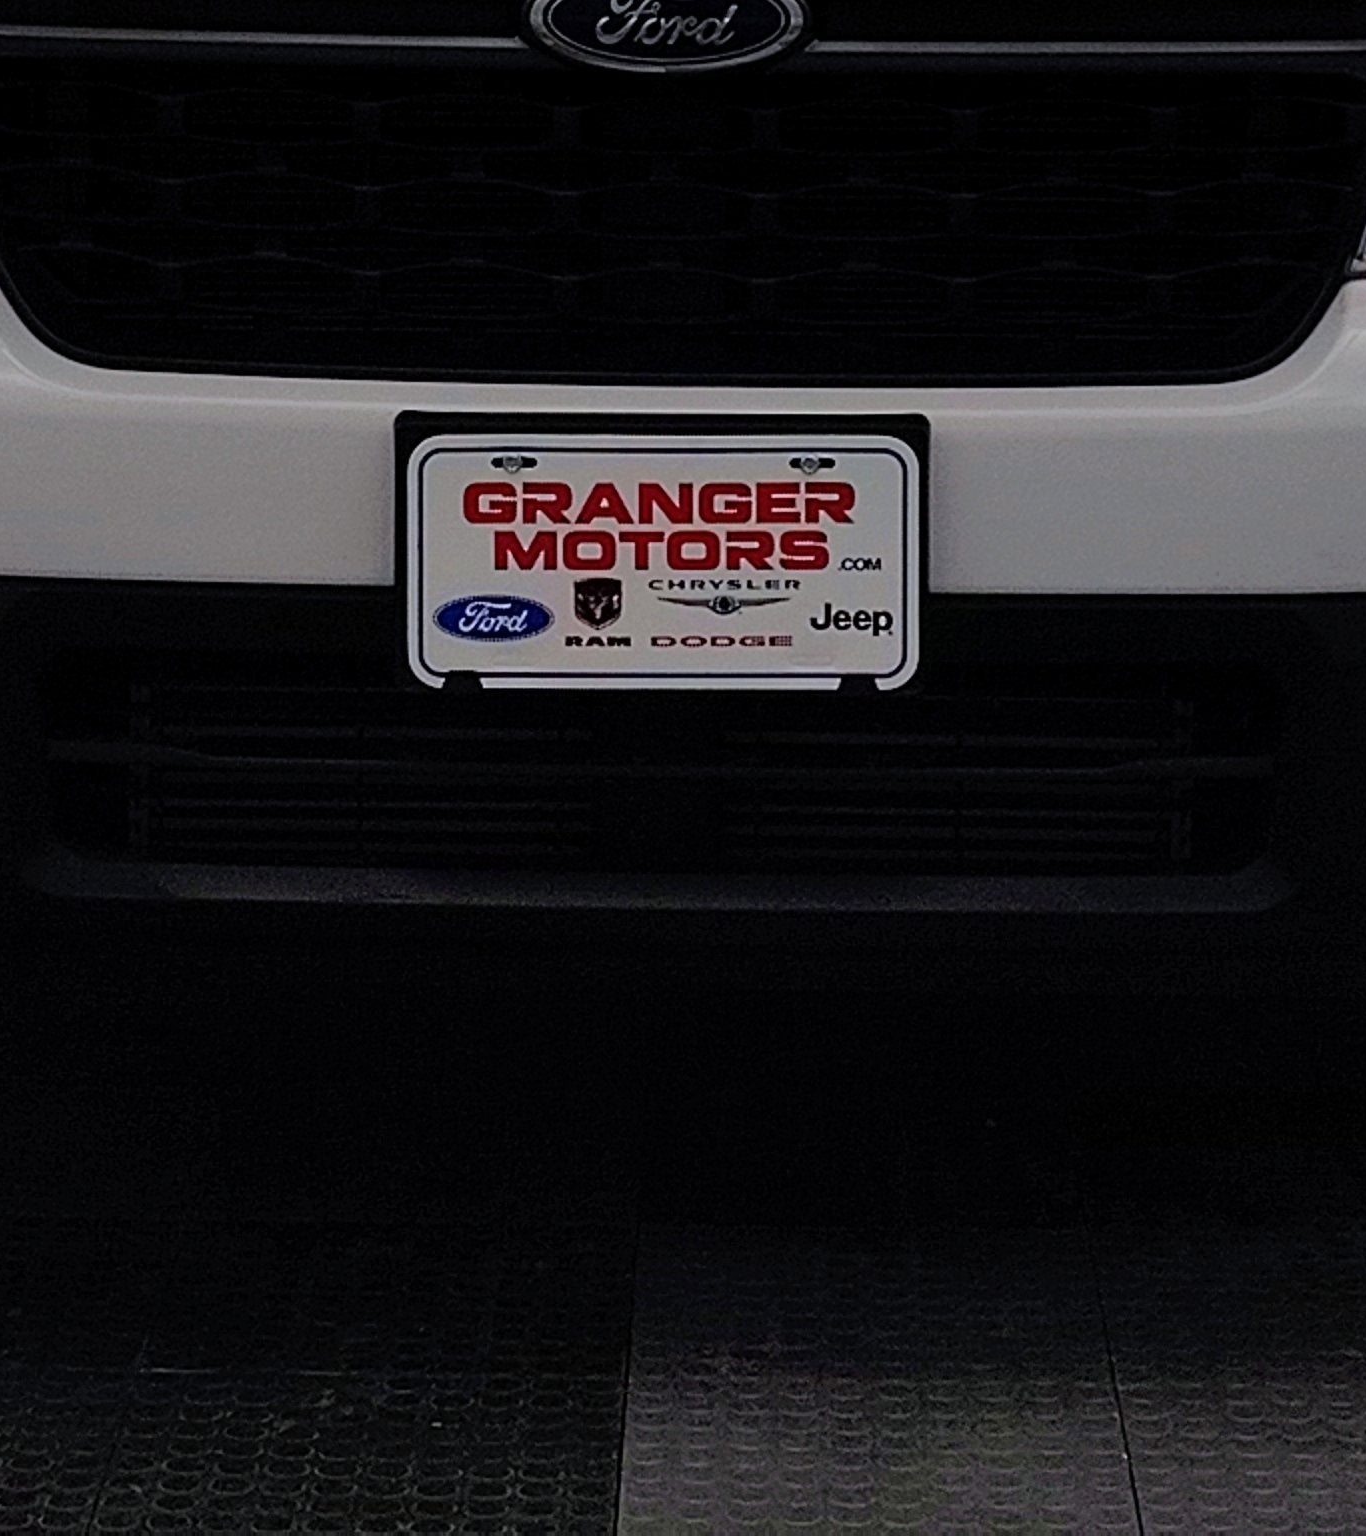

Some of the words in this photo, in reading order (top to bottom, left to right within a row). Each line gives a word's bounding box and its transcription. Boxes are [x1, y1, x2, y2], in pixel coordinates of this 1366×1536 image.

[463, 482, 855, 524] GRANGER
[494, 531, 829, 571] MOTORS
[837, 558, 882, 571] .COM
[648, 579, 801, 590] CHRYSLER
[458, 601, 528, 633] Ford
[810, 602, 893, 637] Jeep
[565, 636, 632, 647] RAM
[651, 635, 793, 648] DODGE
